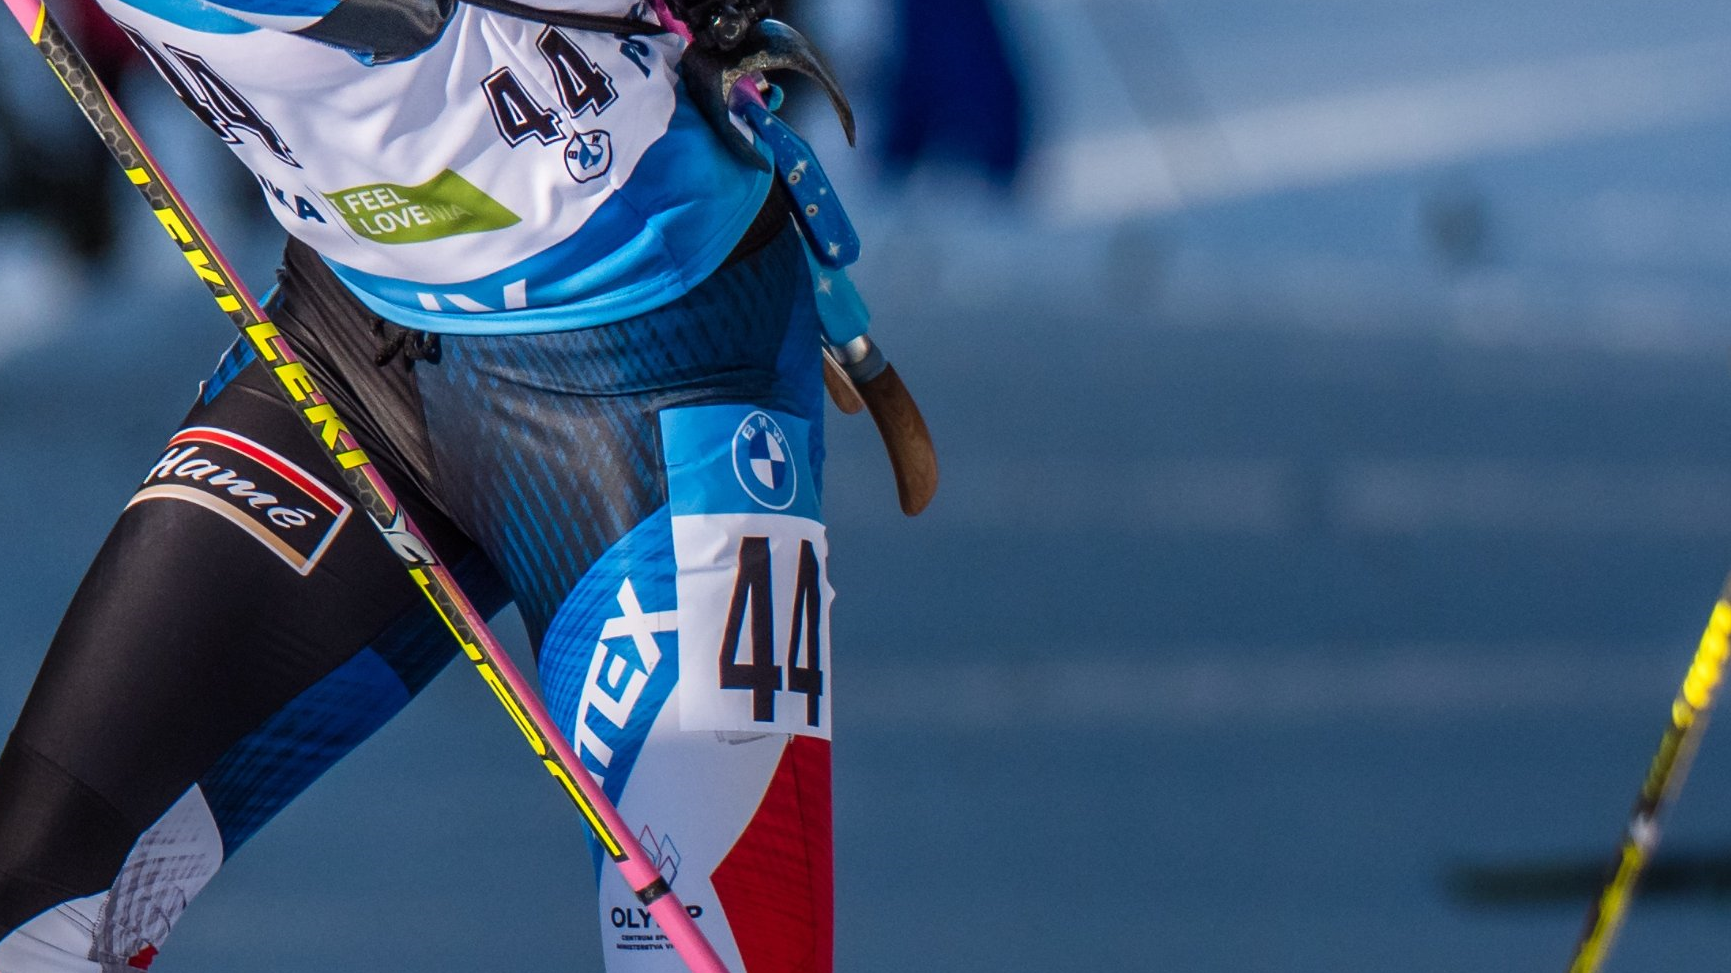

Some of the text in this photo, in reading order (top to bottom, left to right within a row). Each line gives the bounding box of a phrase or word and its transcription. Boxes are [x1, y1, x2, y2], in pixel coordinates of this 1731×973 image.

[481, 22, 619, 149] 44
[343, 187, 410, 214] FEEL
[245, 321, 371, 469] LEKI
[143, 445, 317, 529] Hamé
[574, 576, 679, 785] TEX
[719, 535, 824, 727] 44
[611, 905, 703, 929] OLYP
